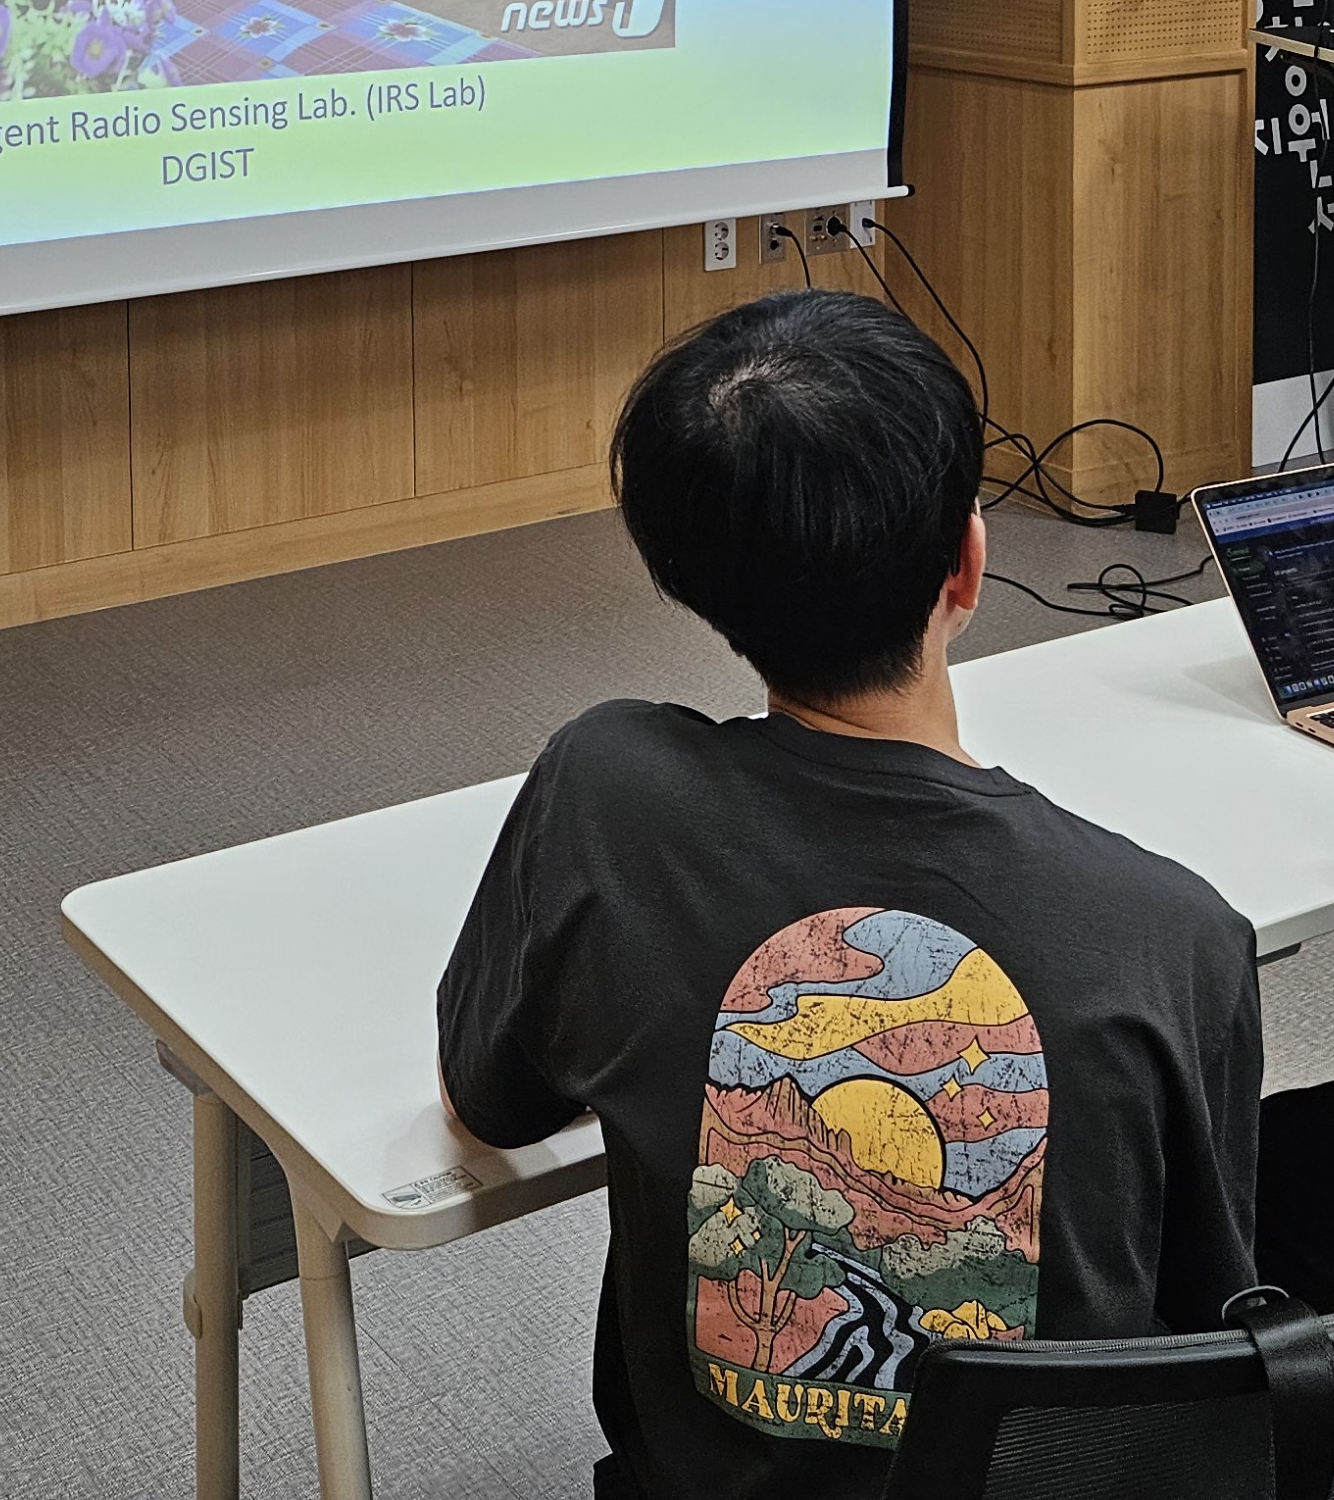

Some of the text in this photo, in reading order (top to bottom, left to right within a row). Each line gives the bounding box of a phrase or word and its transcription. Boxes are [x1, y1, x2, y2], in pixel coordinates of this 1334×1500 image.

[71, 105, 162, 142] Radio
[170, 95, 289, 134] Sensing
[296, 91, 357, 120] Lab.
[366, 81, 421, 122] (IRS
[428, 75, 488, 113] Lab)
[160, 146, 255, 186] DGIST
